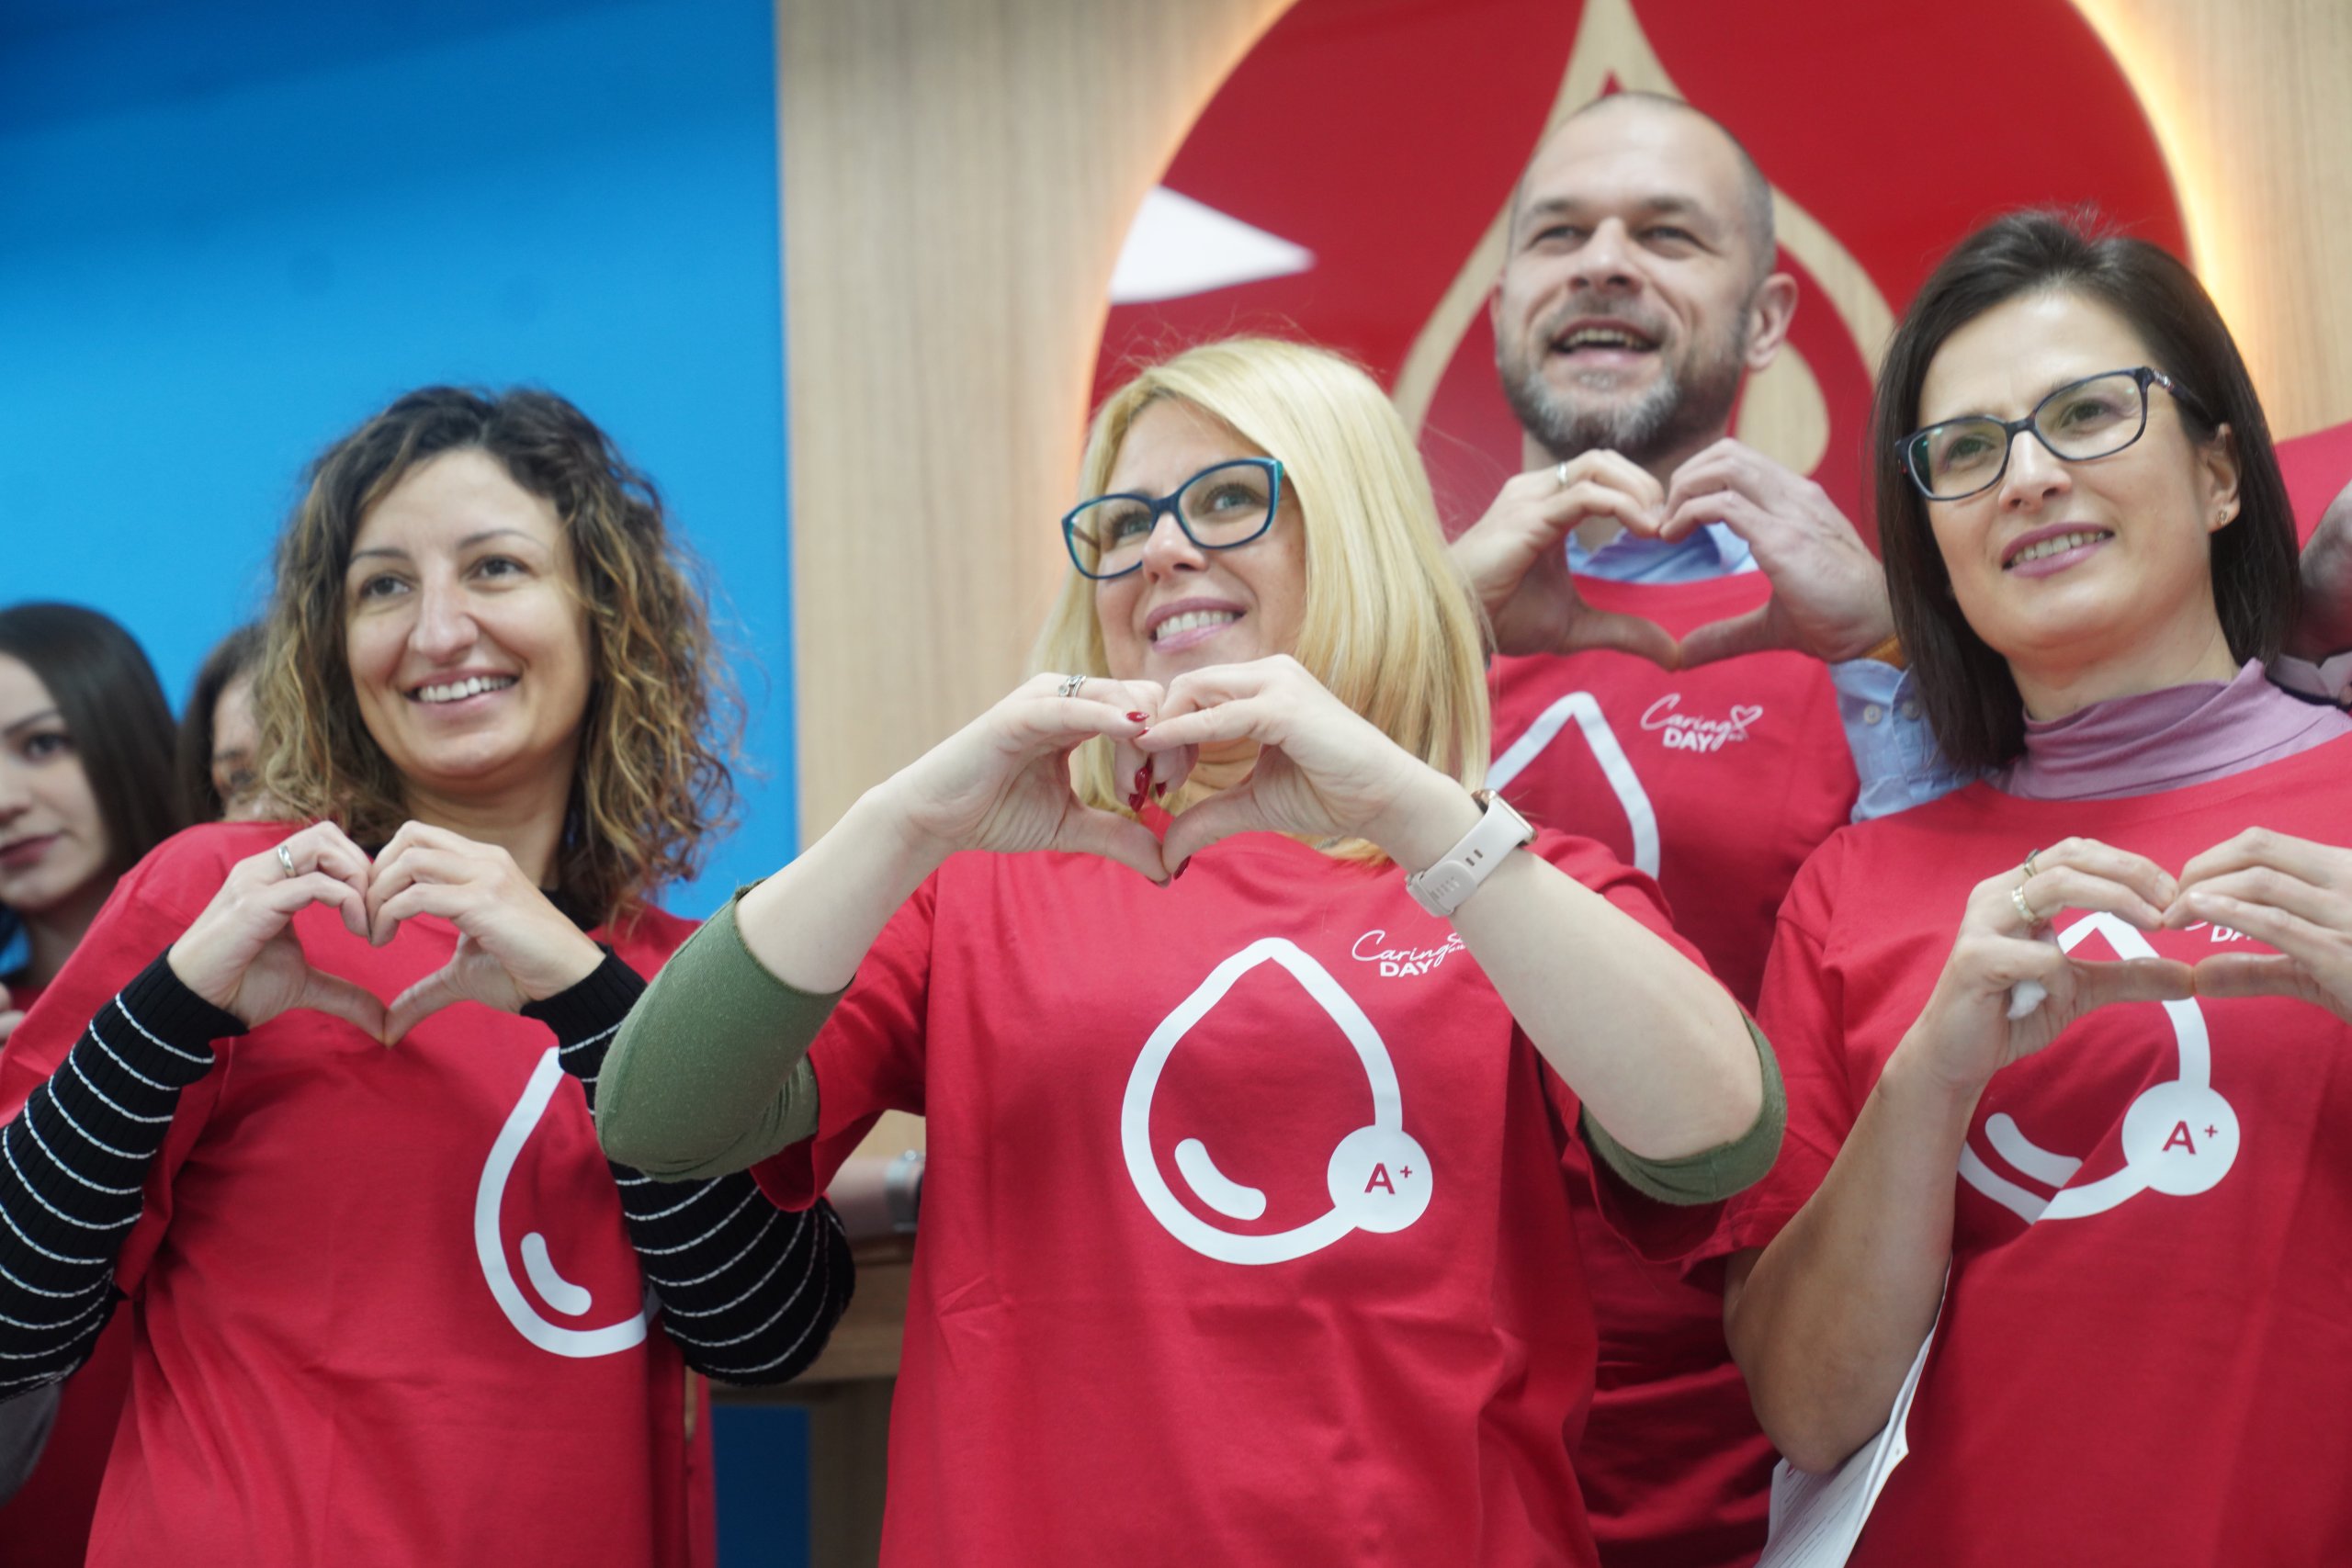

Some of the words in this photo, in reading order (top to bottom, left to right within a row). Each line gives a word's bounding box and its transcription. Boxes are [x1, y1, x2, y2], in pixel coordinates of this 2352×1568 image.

[1640, 693, 1733, 751] Caring
[1662, 727, 1714, 753] DAY
[1351, 929, 1450, 968] Caring
[1379, 958, 1434, 978] DAY
[2162, 1120, 2219, 1156] A+
[1363, 1162, 1413, 1196] A+
